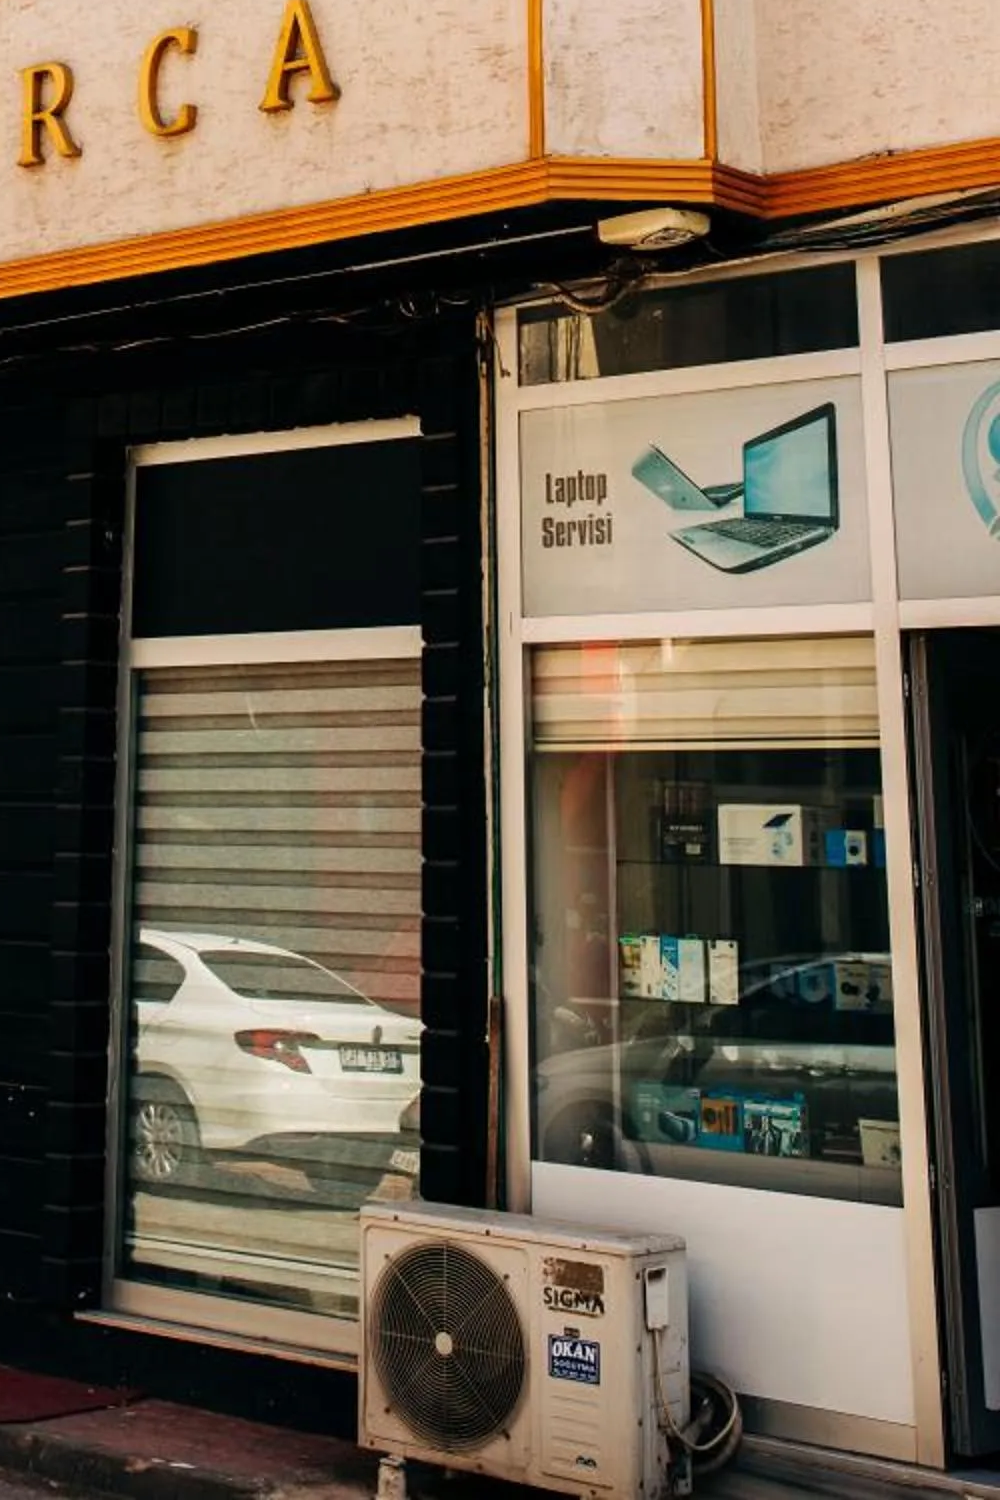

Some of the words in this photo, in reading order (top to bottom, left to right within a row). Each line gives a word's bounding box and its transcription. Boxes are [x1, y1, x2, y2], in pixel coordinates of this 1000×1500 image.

[545, 469, 607, 508] Laptop
[542, 512, 613, 549] Servisi
[543, 1286, 605, 1315] SIGMA
[552, 1341, 595, 1364] OKAN
